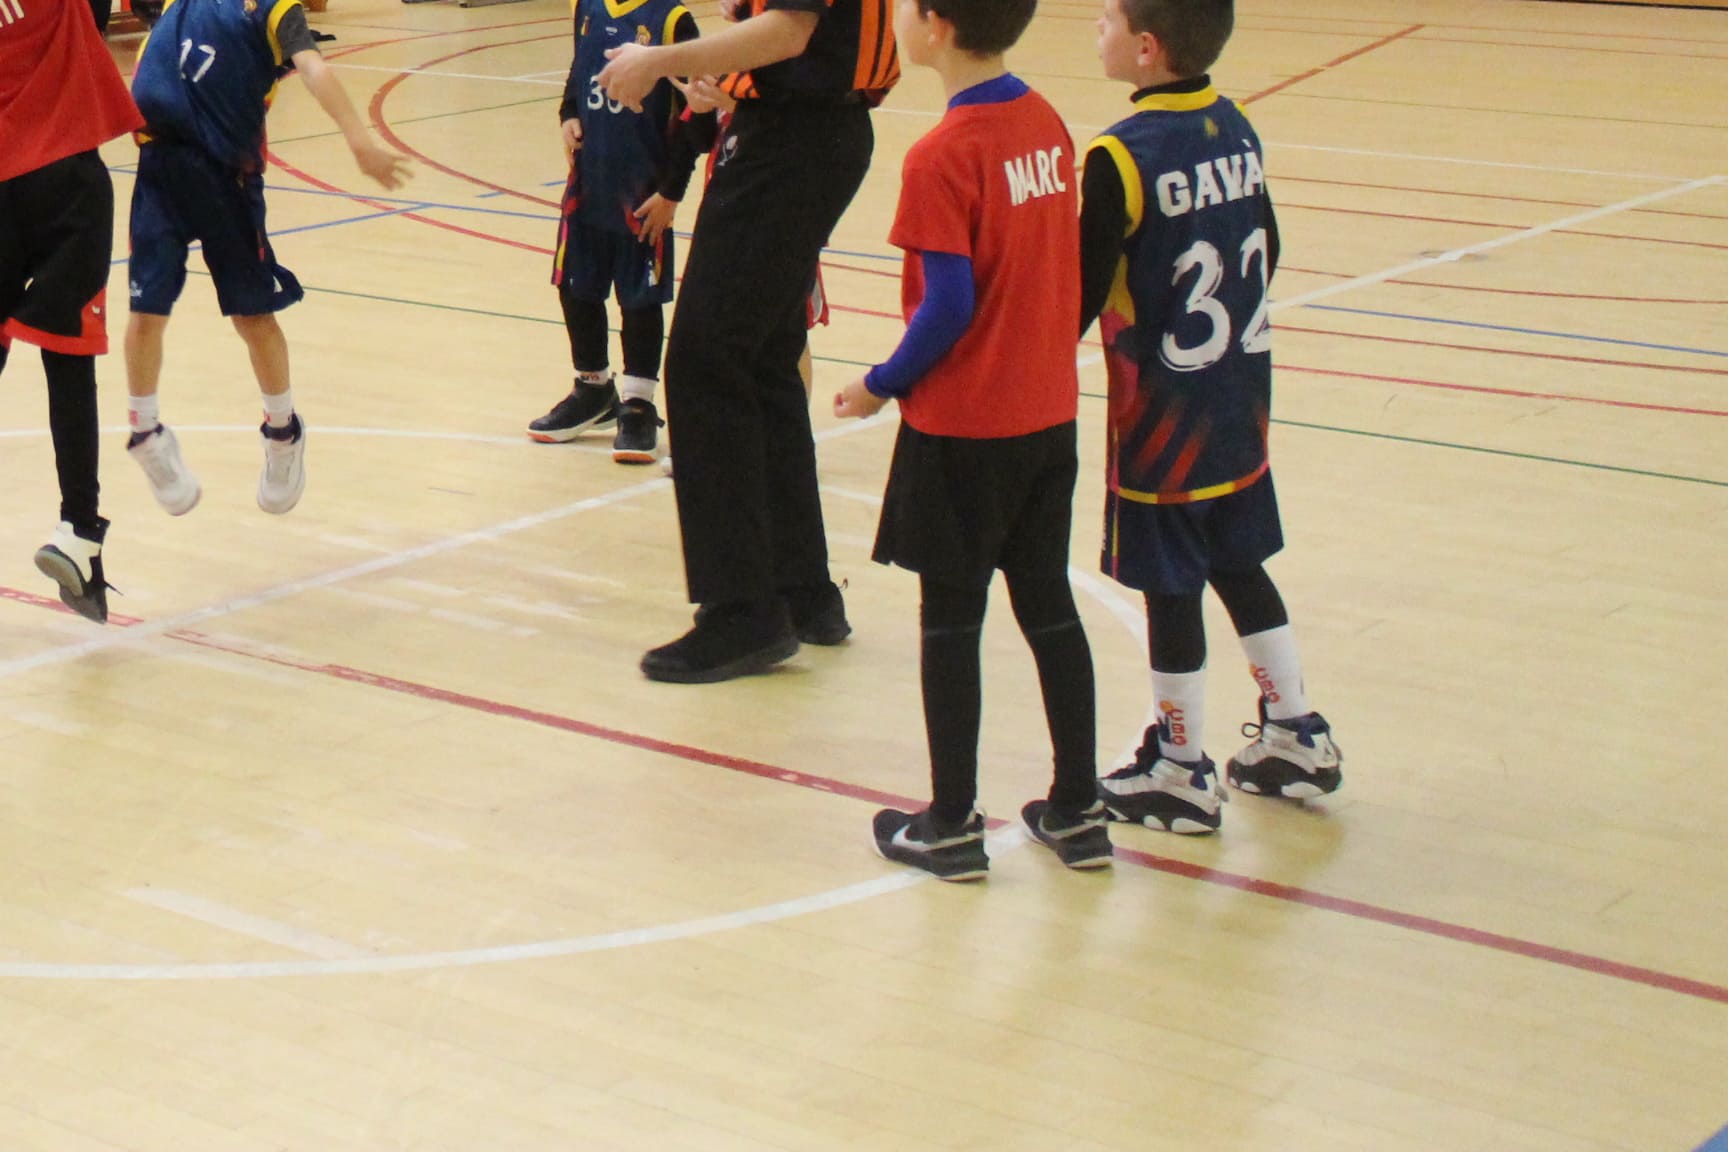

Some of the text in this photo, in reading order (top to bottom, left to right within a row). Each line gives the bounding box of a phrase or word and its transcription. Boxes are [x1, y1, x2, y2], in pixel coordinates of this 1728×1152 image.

[179, 38, 217, 82] 17
[1004, 146, 1067, 207] MARC
[1155, 138, 1265, 218] GAVÀ
[1157, 227, 1271, 372] 32
